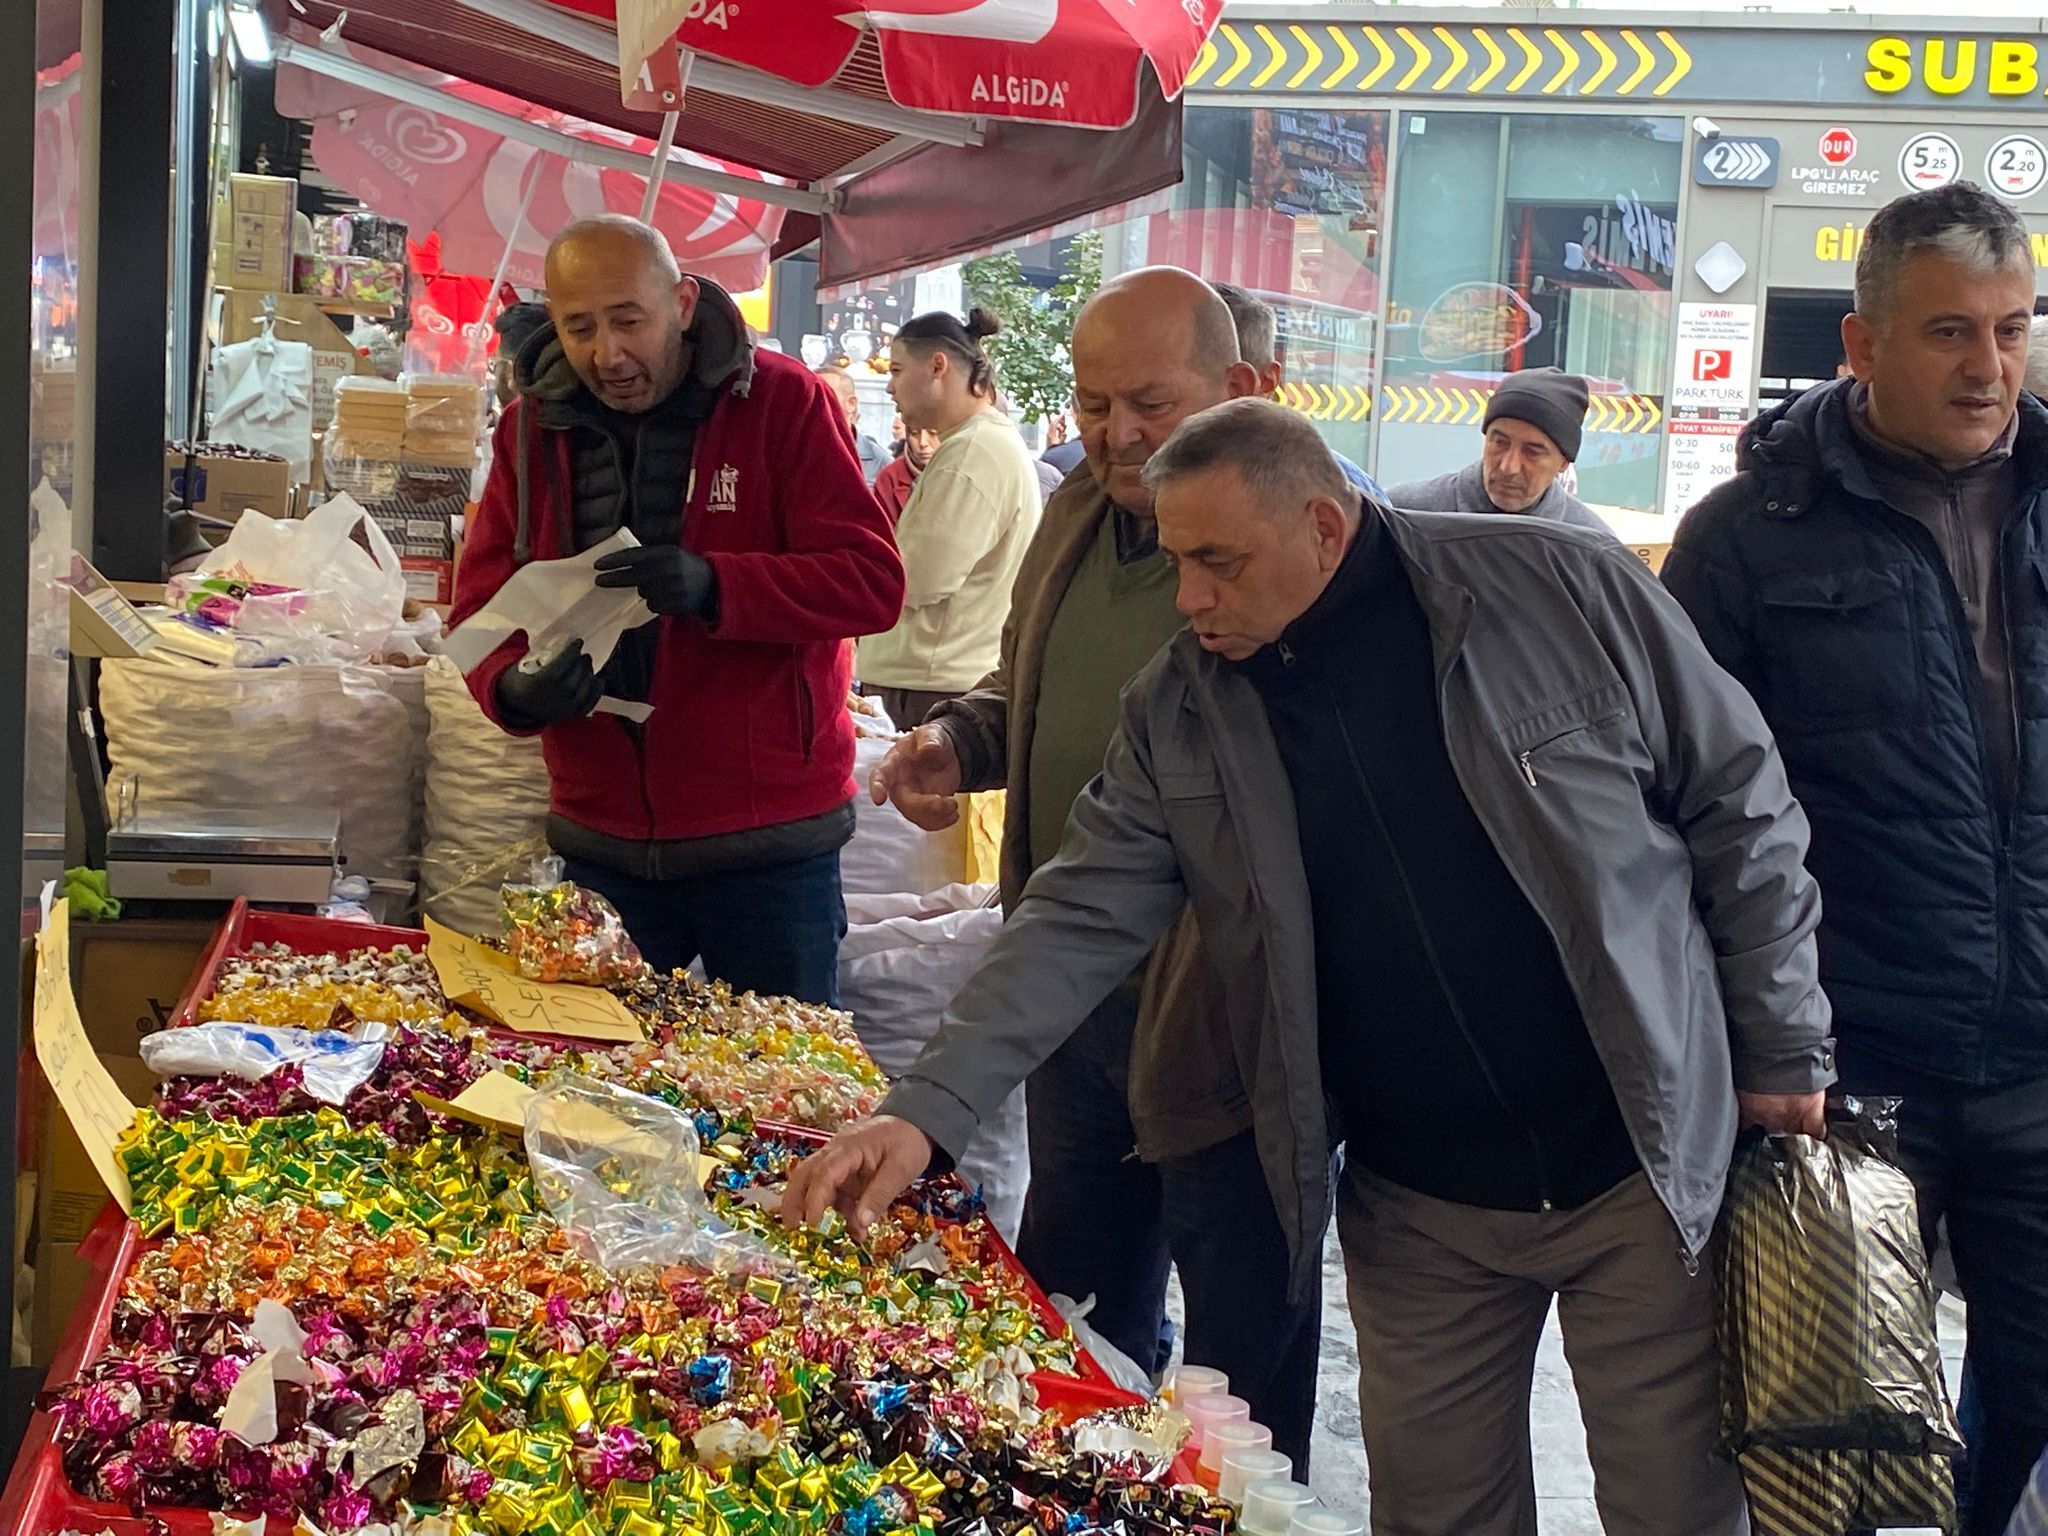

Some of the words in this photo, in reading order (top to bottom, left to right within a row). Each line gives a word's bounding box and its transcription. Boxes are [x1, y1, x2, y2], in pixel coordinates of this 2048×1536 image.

[1864, 36, 2048, 96] SUB
[1824, 140, 1851, 154] DUR
[1713, 146, 1730, 173] 2
[1839, 169, 1880, 184] ARAÇ
[1802, 181, 1867, 196] GİREMEZ
[1674, 423, 1699, 433] FİYAT
[1671, 460, 1700, 470] 30-60
